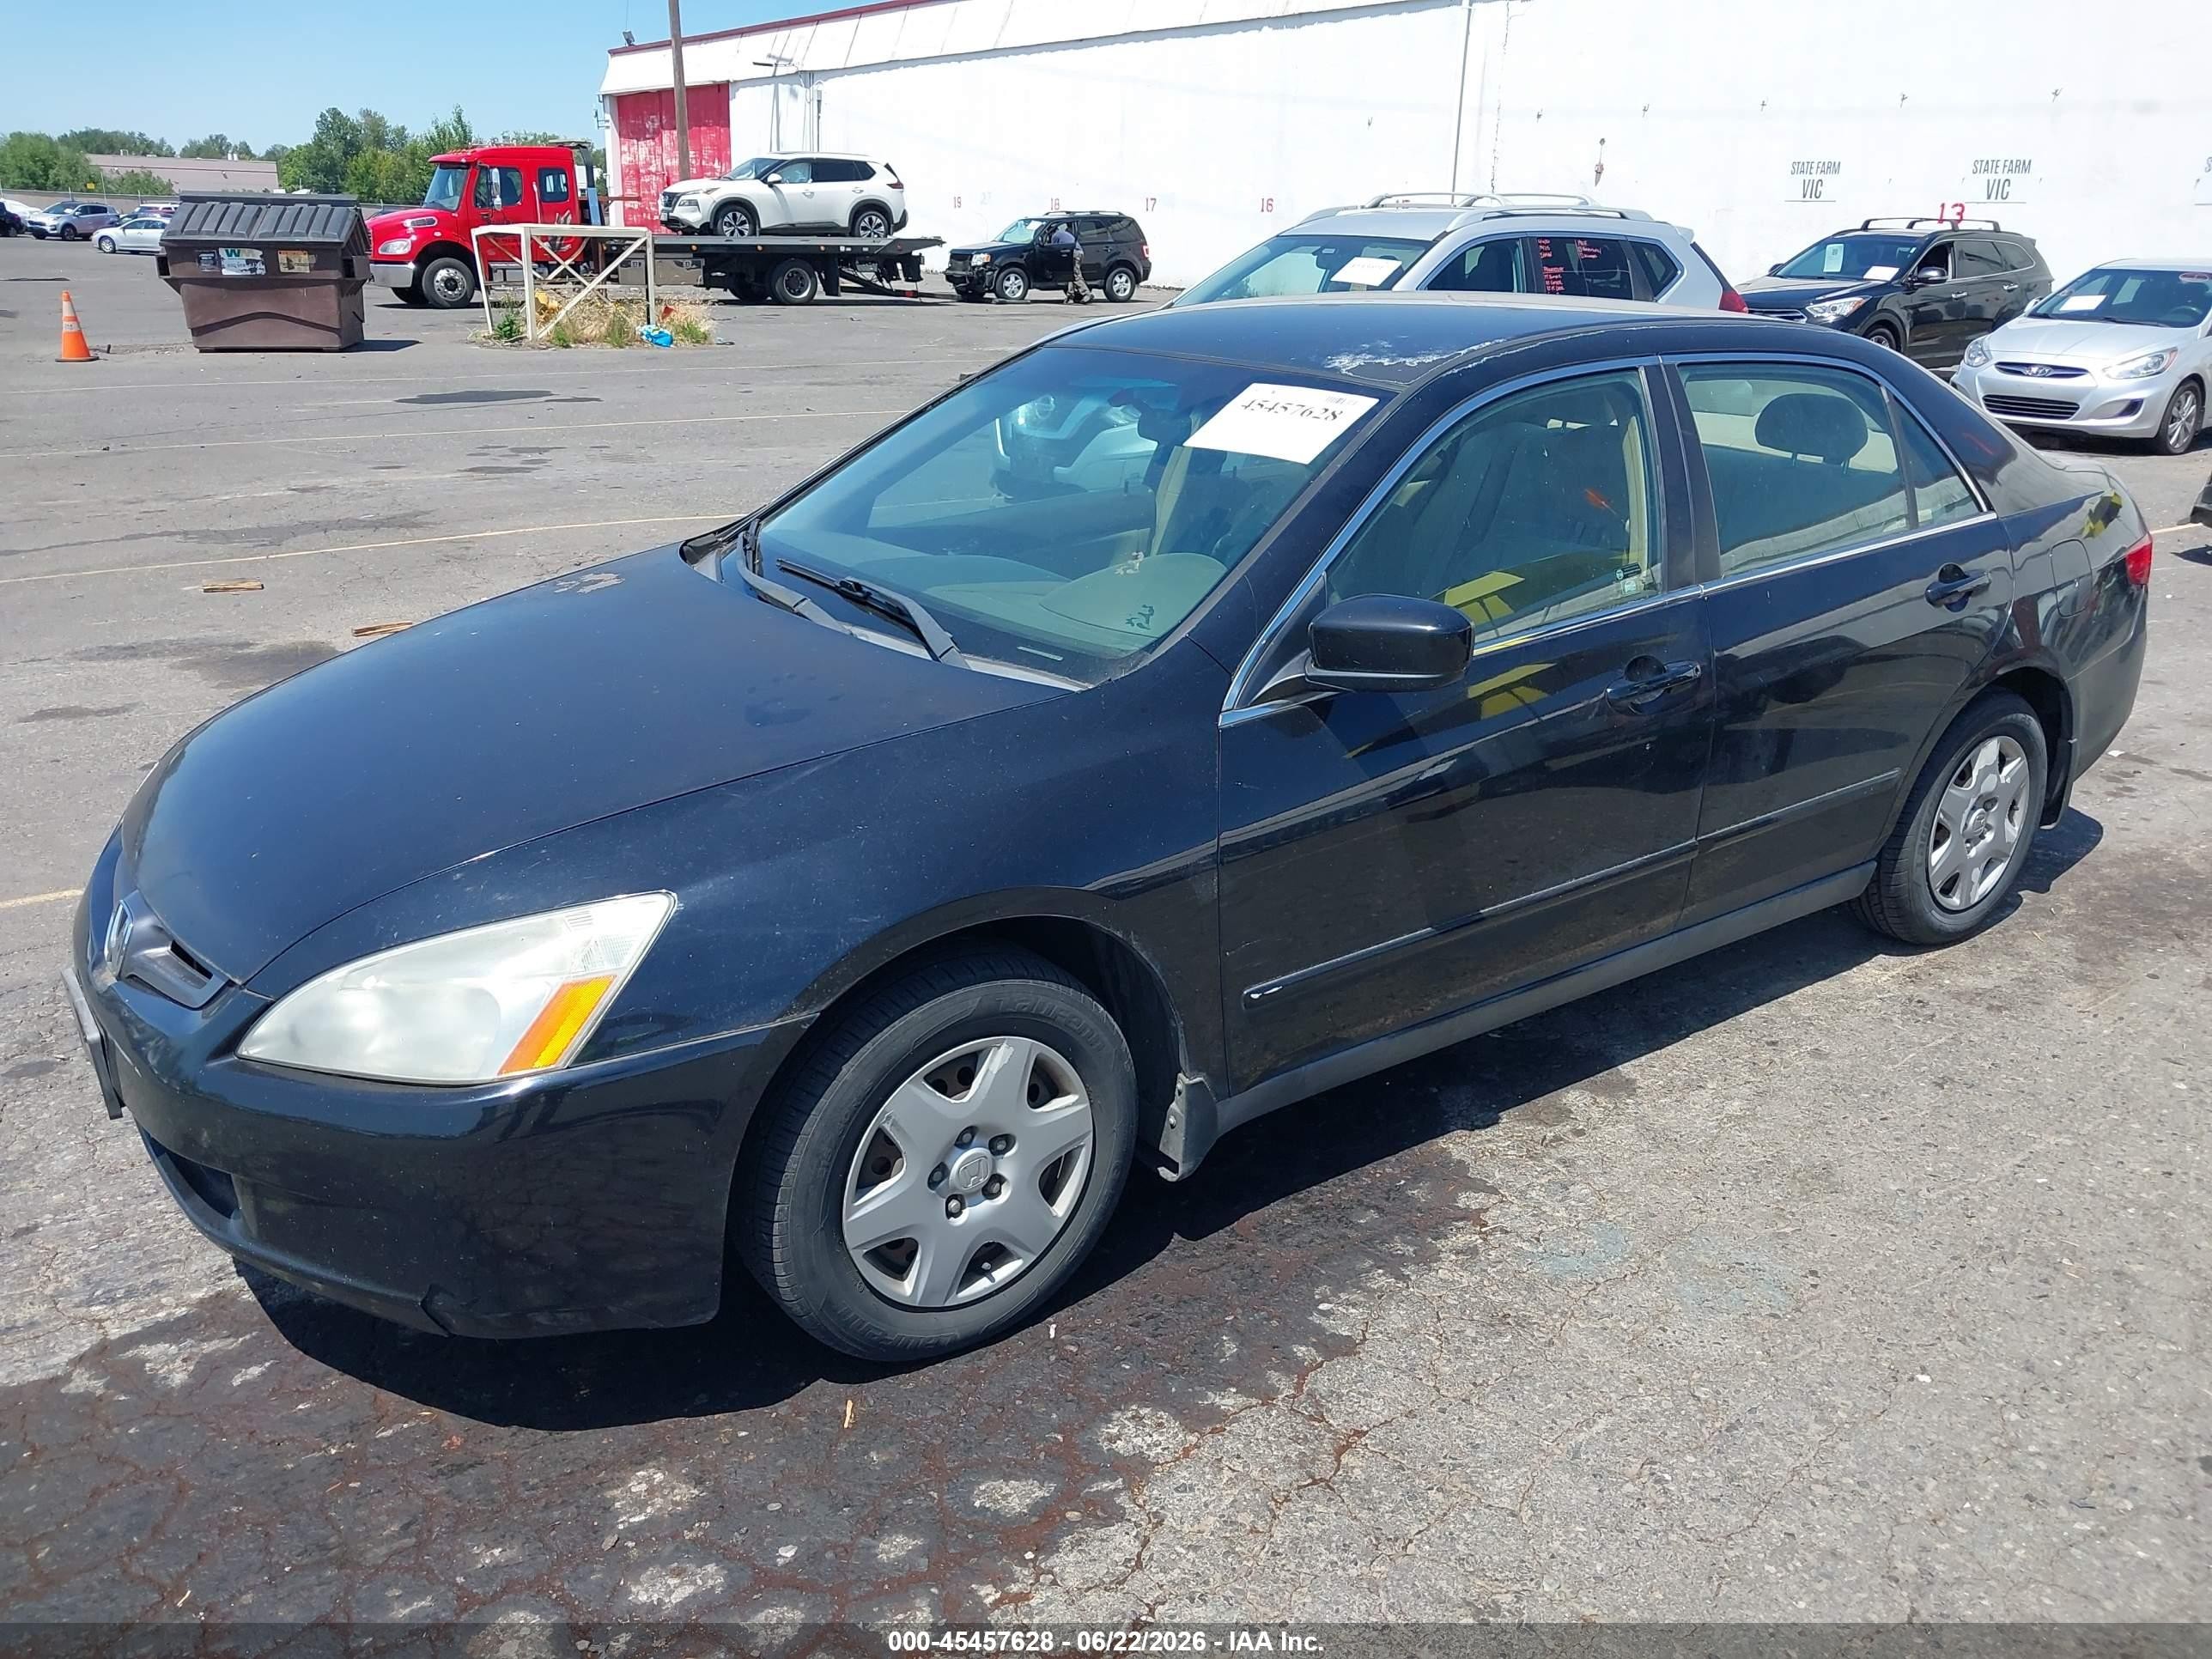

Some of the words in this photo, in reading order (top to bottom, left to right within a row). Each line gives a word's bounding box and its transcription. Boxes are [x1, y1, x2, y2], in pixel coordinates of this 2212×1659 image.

[1790, 161, 1814, 175] STATE
[1815, 161, 1841, 175] FARM
[1972, 160, 2000, 174] STATE
[2002, 160, 2032, 174] FARM
[1802, 179, 1824, 199] VIC
[1986, 178, 2011, 200] VIC
[953, 197, 962, 209] 19
[1050, 198, 1060, 210] 18
[1146, 198, 1158, 212] 17
[1261, 198, 1274, 213] 16
[1937, 203, 1966, 224] 13
[1241, 399, 1344, 421] 45457628
